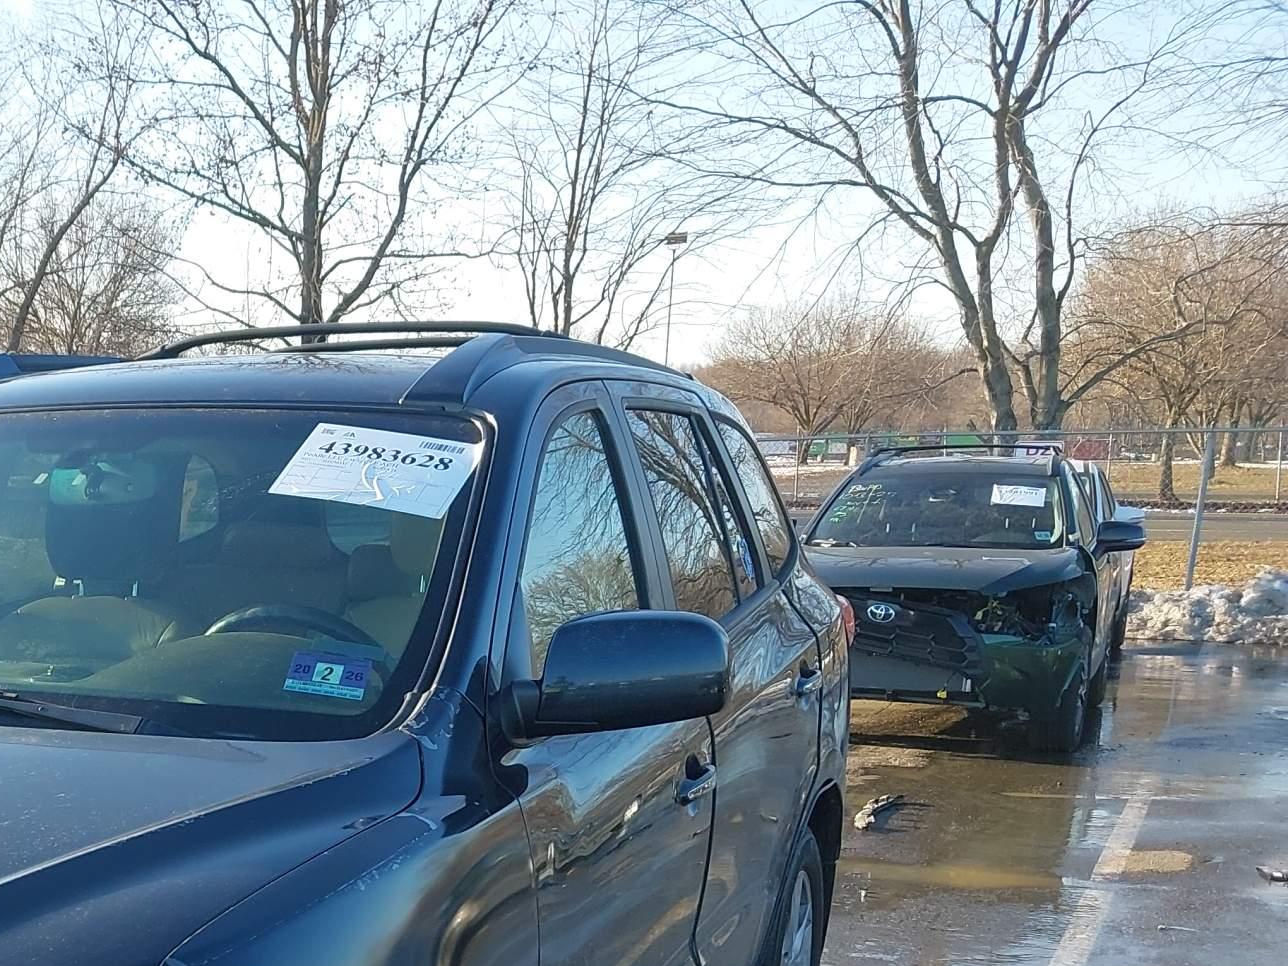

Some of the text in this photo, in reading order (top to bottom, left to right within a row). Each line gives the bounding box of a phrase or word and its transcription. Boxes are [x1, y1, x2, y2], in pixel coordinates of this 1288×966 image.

[318, 441, 453, 471] 43983628
[294, 663, 364, 682] 20 2 26
